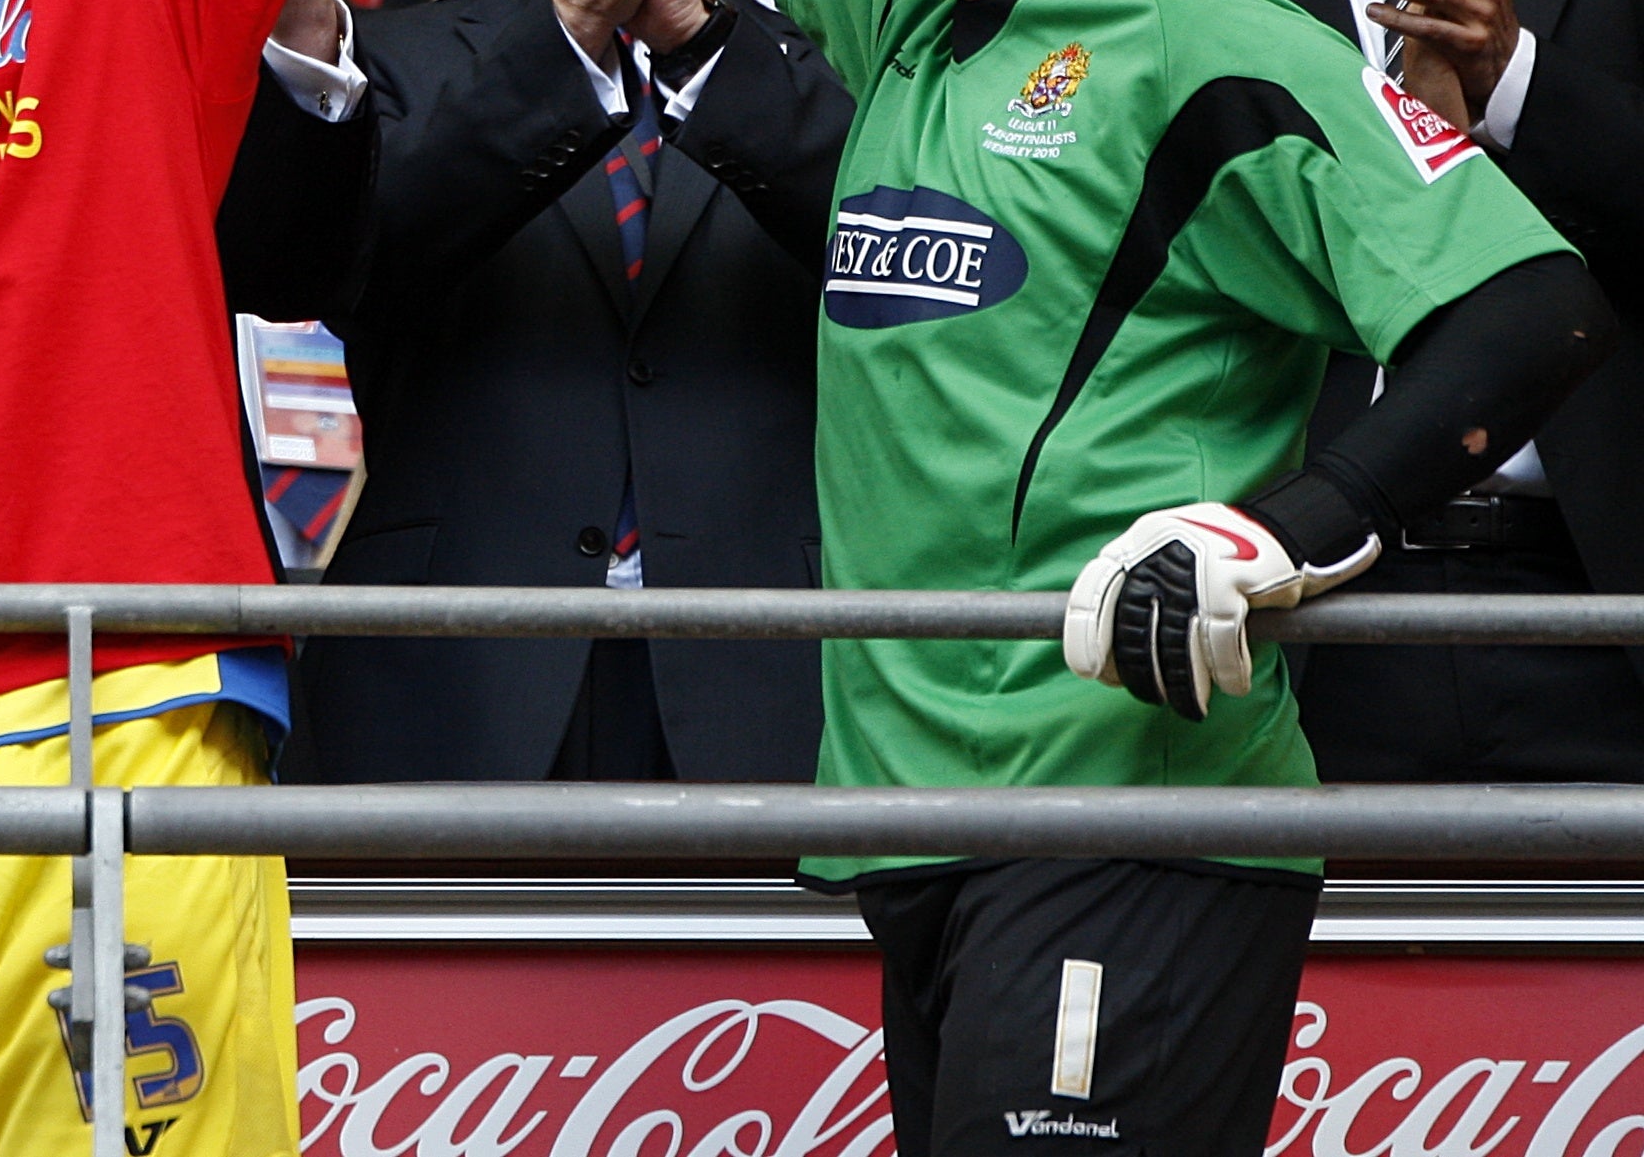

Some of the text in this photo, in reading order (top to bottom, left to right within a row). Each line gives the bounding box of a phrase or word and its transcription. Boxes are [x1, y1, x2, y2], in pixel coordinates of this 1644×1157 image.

[1007, 117, 1046, 133] LEAGUE
[1023, 130, 1077, 145] FINALISTS
[982, 139, 1061, 159] WEMBLEY 2010
[831, 230, 988, 288] EST & COE
[1051, 958, 1103, 1101] 1
[1004, 1109, 1120, 1139] Vandanel
